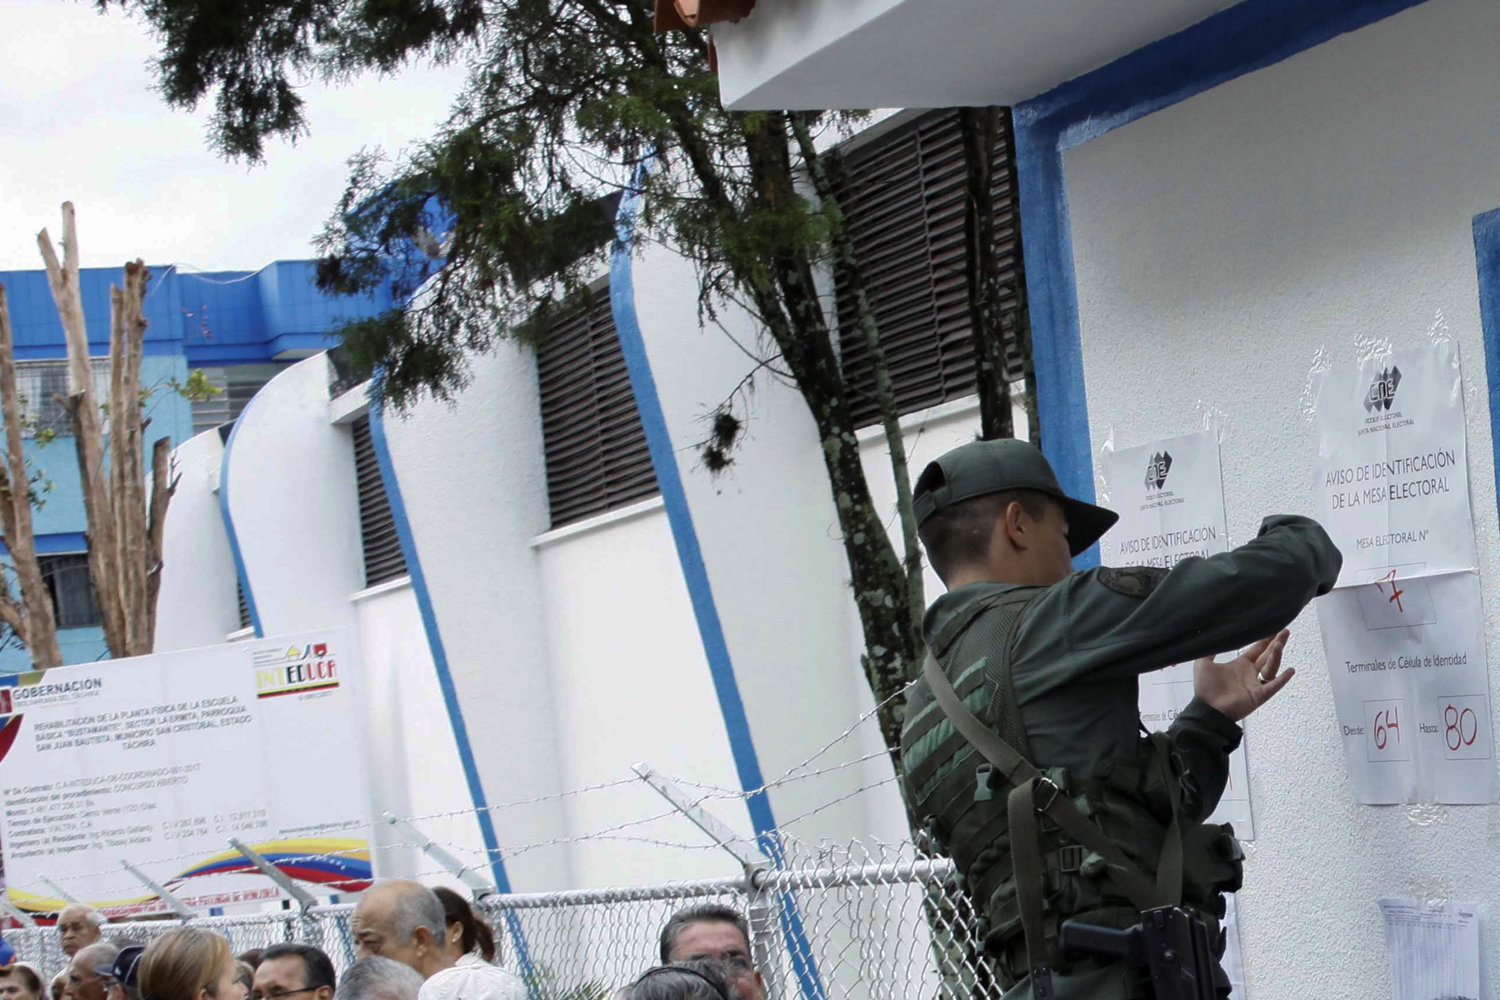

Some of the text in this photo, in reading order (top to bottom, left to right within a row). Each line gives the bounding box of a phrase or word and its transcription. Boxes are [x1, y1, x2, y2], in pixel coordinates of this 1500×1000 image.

[1326, 448, 1456, 487] AVISO DE IDENTIFICACIÓN
[1332, 476, 1450, 510] DE LA MESA ELECTORAL
[1120, 540, 1140, 555] AVISO
[1141, 537, 1151, 552] DE
[1356, 538, 1374, 550] MESA
[1375, 531, 1418, 547] ELECTORAL
[1374, 568, 1404, 613] 7
[1345, 659, 1386, 674] Terminales
[1388, 658, 1396, 670] de
[1423, 656, 1432, 668] de
[1432, 652, 1467, 667] Identidad
[12, 677, 102, 701] GOBERNACIÓN
[1374, 706, 1400, 750] 64
[1444, 704, 1477, 751] 80
